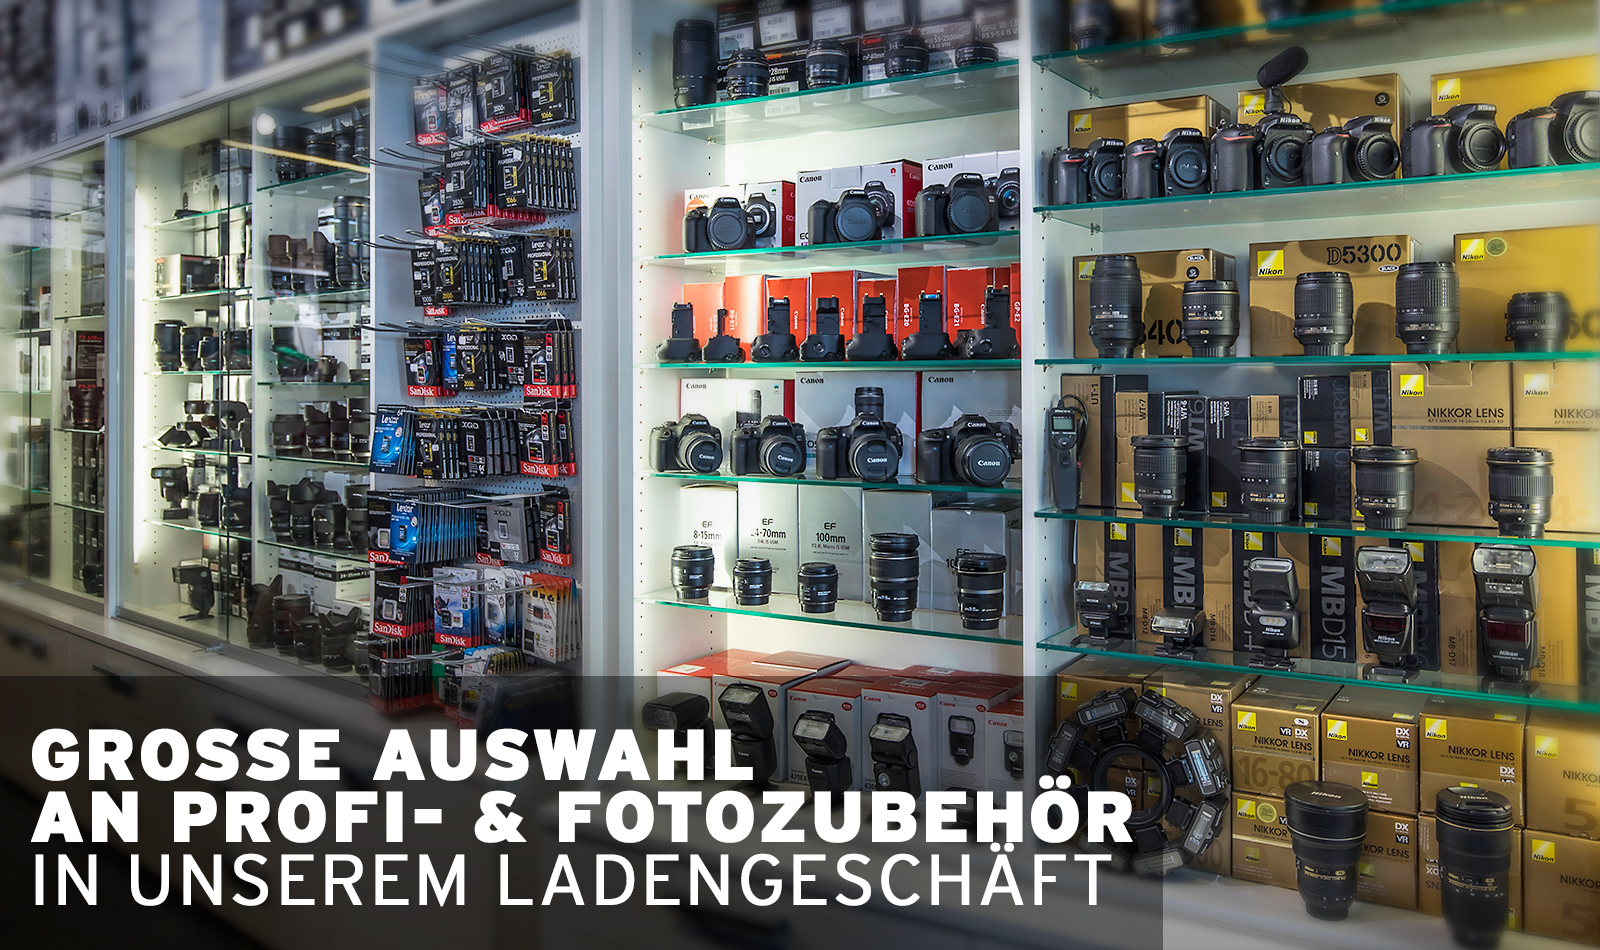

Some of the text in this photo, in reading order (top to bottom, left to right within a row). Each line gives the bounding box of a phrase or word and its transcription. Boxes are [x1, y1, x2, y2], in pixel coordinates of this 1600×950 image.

[1477, 104, 1496, 112] Nikon
[928, 162, 954, 172] Canon
[799, 175, 822, 183] Canon
[500, 246, 516, 254] XQD
[1326, 243, 1402, 266] D5300
[1258, 268, 1283, 276] Nikon
[928, 376, 954, 384] Canon
[409, 386, 434, 396] SanDisk
[526, 386, 552, 396] SanDisk
[1091, 383, 1099, 405] UT-1
[1139, 398, 1147, 421] WT-7
[1180, 400, 1188, 420] WT-6
[1428, 408, 1504, 418] NIKKOR LENS
[381, 414, 400, 424] Lexar
[462, 421, 479, 429] XQD
[778, 454, 794, 463] Canon
[523, 463, 550, 476] SanDisk
[396, 503, 414, 513] Lexar
[702, 520, 713, 528] EF
[762, 518, 774, 526] EF
[824, 522, 836, 530] EF
[693, 530, 722, 540] 8-15mm
[750, 528, 786, 538] 24-70mm
[816, 532, 846, 544] 100mm
[542, 551, 564, 564] SanDisk
[1320, 565, 1346, 660] MBD15
[374, 622, 403, 636] SanDisk
[440, 634, 466, 646] SanDisk
[1448, 636, 1456, 667] MB-D17
[1210, 694, 1223, 702] DX
[1212, 705, 1223, 713] VR
[988, 719, 1008, 728] Canon
[1204, 718, 1224, 728] LENS
[1280, 728, 1308, 737] VR DX
[1327, 732, 1347, 740] Nikon
[1396, 728, 1410, 736] DX
[1254, 736, 1288, 748] NIKKOR
[1291, 741, 1312, 752] LENS
[1397, 740, 1409, 749] VR
[1348, 748, 1385, 760] NIKKOR
[1387, 752, 1410, 764] LENS
[1448, 746, 1488, 758] NIKKOR
[1490, 751, 1516, 762] LENS
[1536, 750, 1558, 758] Nikon
[1239, 756, 1316, 792] 16-80
[1500, 766, 1515, 776] DX
[1124, 776, 1137, 784] DX
[1310, 790, 1342, 799] Nikon
[1238, 811, 1255, 819] Nikon
[1254, 824, 1288, 838] NIKKOR
[1394, 822, 1409, 832] DX
[1396, 835, 1409, 844] VR
[1386, 848, 1410, 859] LENS
[1533, 854, 1554, 862] Nikon
